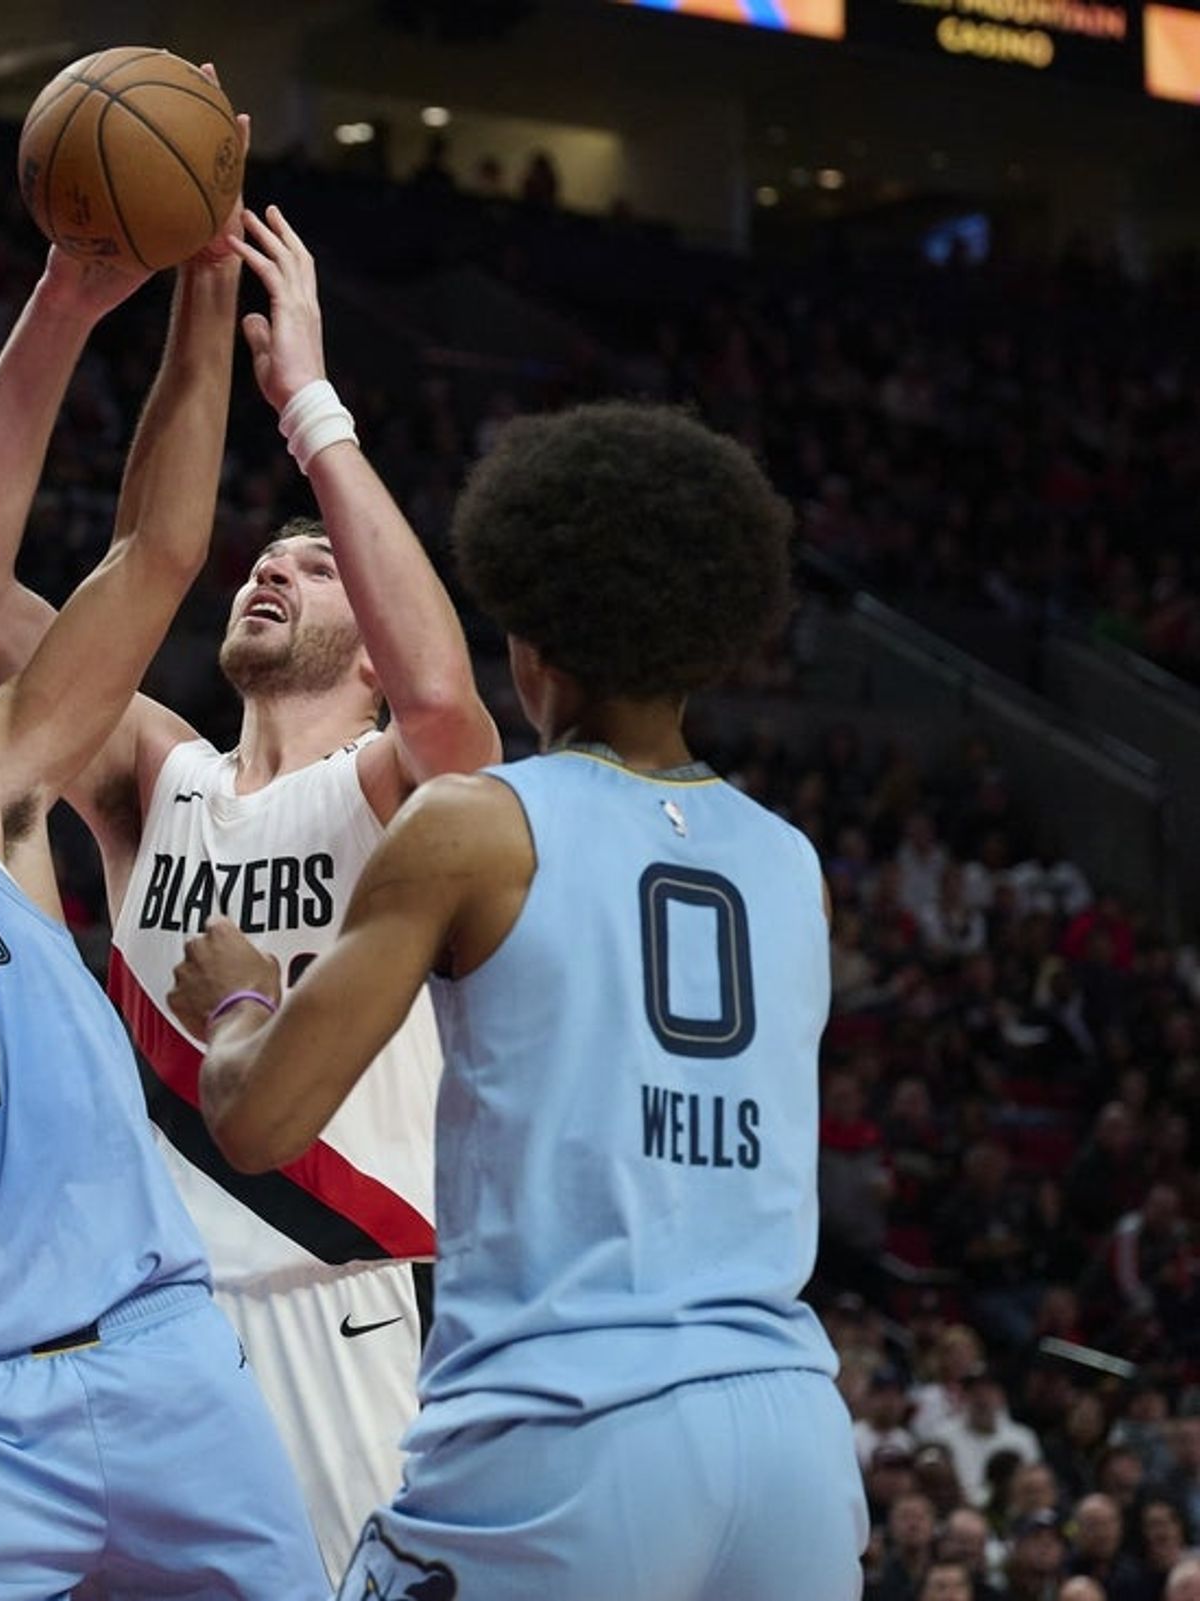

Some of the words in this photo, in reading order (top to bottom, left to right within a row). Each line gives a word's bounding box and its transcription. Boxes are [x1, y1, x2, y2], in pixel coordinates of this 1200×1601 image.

[138, 852, 334, 933] BLAZERS
[638, 862, 756, 1059] 0
[641, 1084, 760, 1170] WELLS
